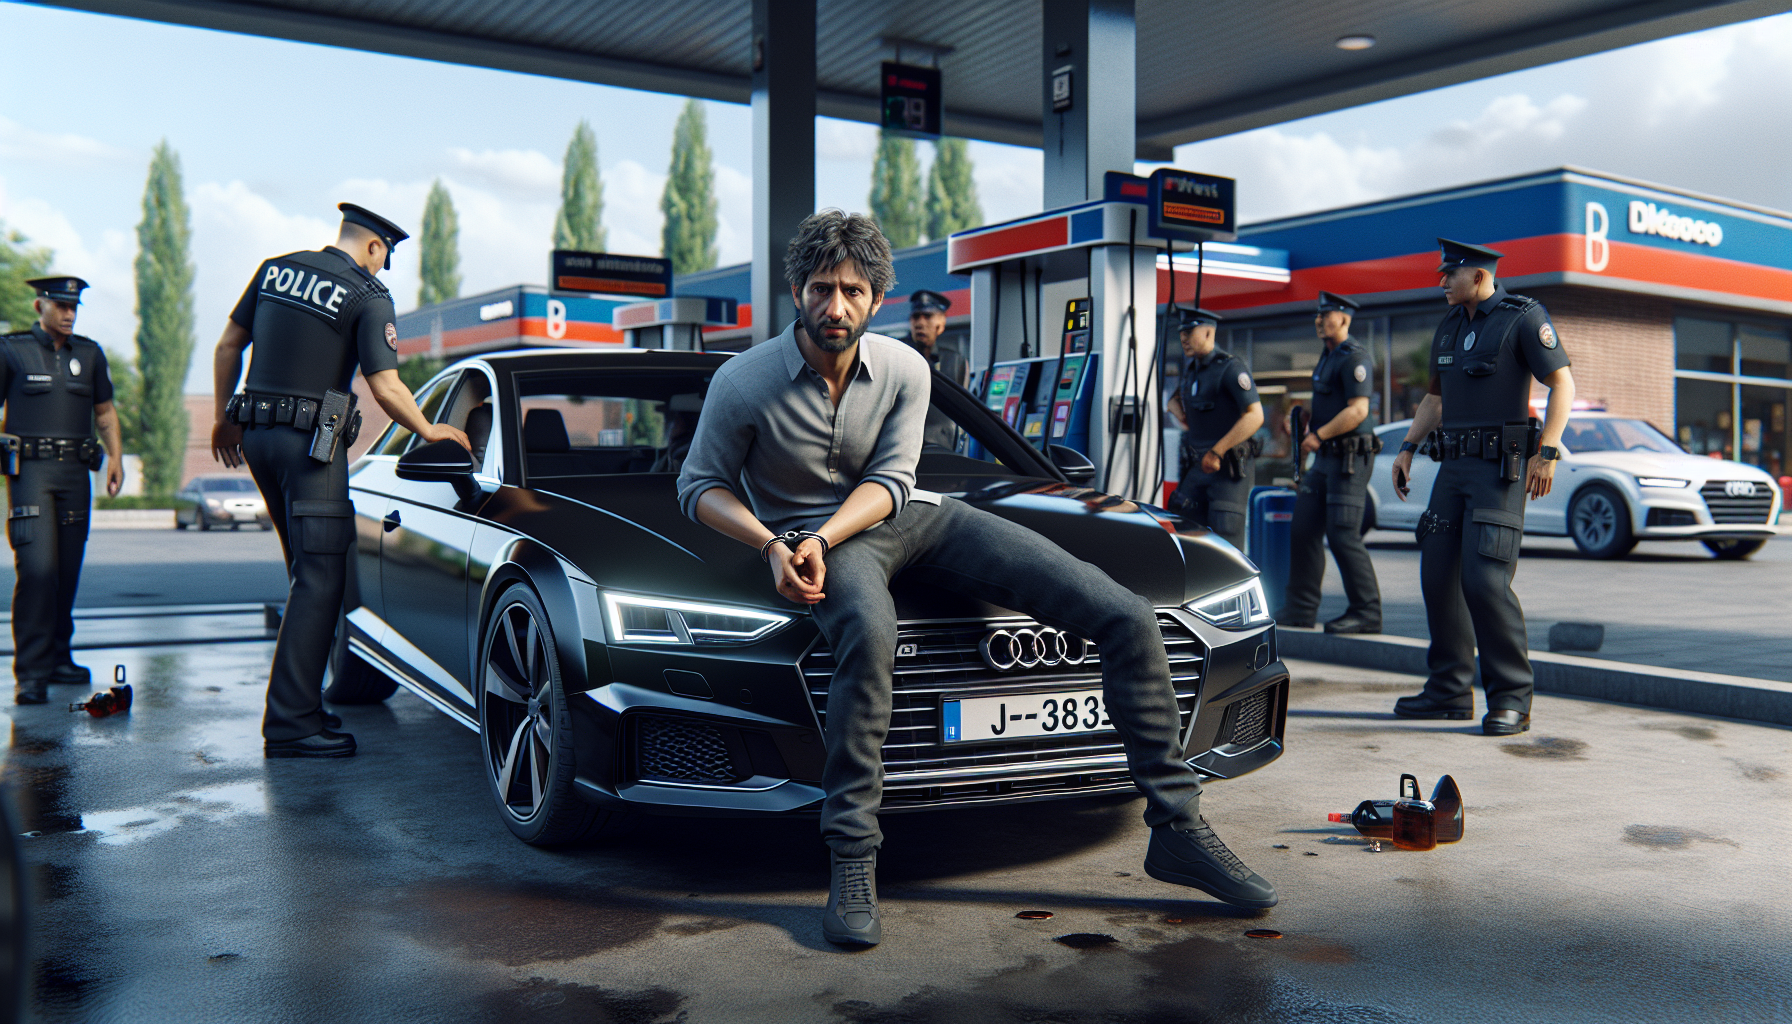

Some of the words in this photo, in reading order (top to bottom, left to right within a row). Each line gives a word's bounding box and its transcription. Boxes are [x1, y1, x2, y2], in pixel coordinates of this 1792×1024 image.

[1585, 202, 1609, 272] B
[261, 265, 348, 313] POLICE
[547, 299, 567, 340] B
